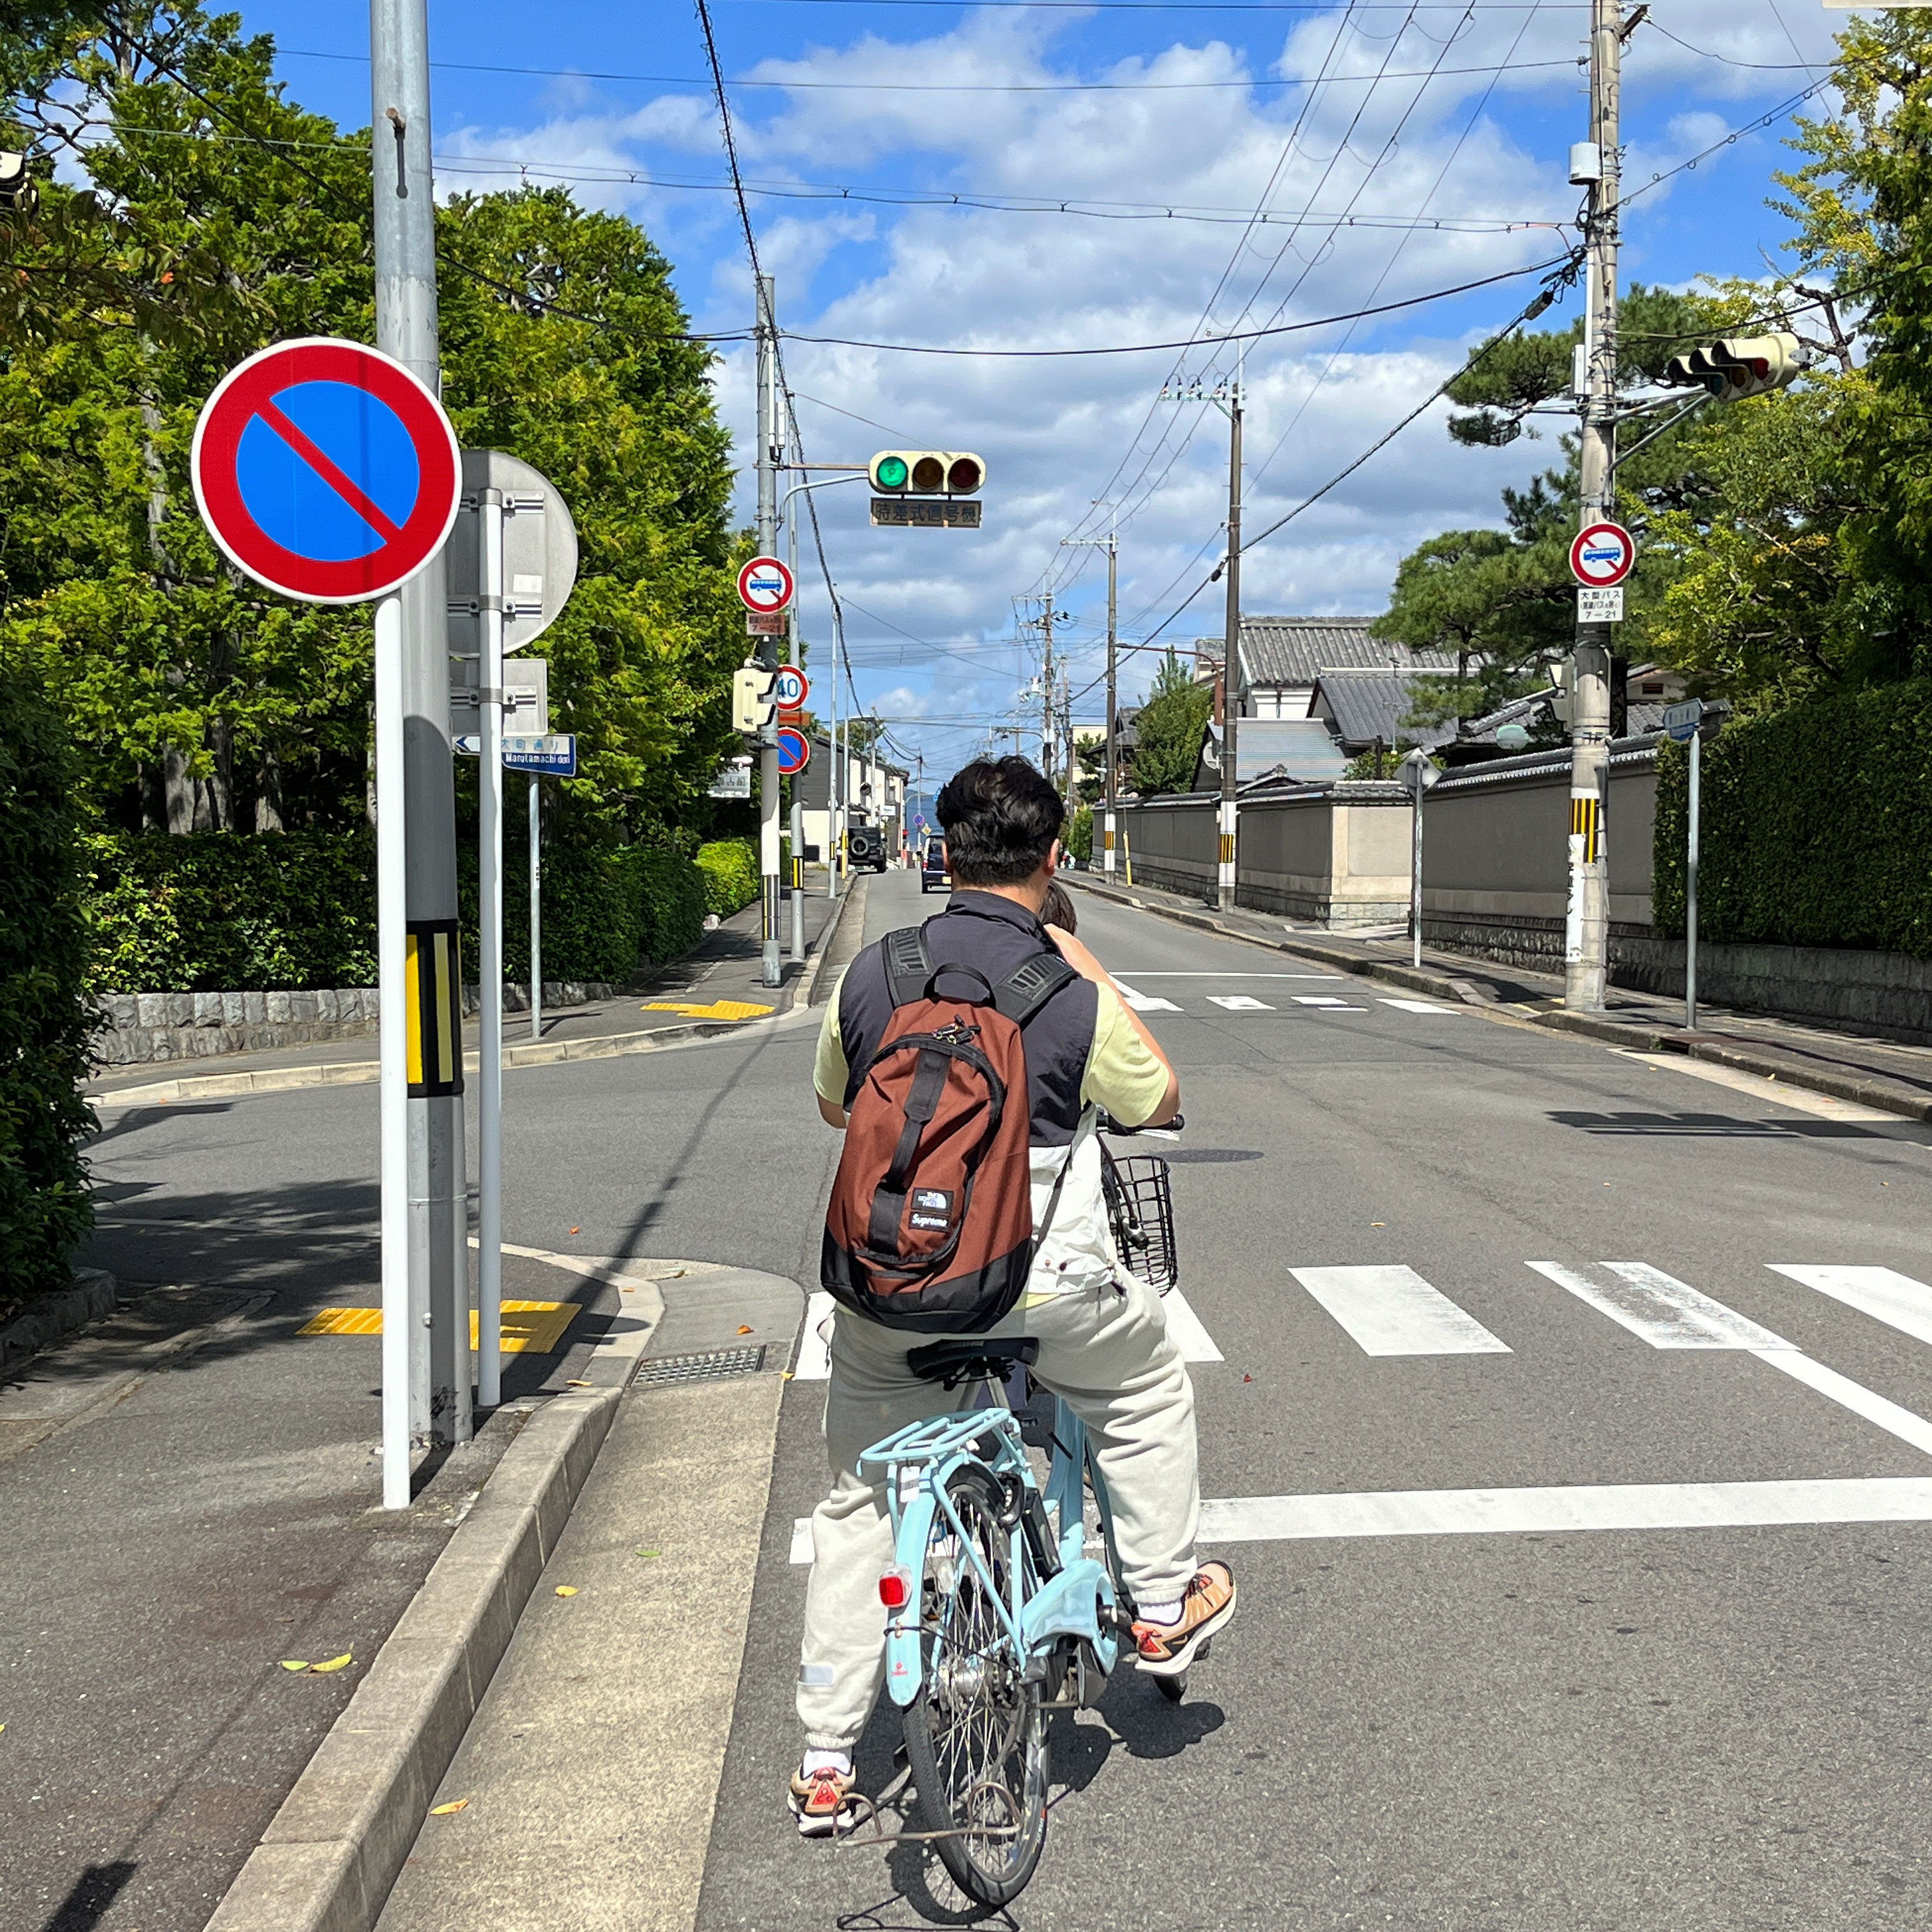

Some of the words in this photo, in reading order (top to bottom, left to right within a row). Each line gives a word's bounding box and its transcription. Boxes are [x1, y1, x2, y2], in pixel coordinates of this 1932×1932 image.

[875, 503, 976, 523] 時差式信号機
[778, 678, 798, 698] 40
[505, 753, 556, 763] Marutamachi
